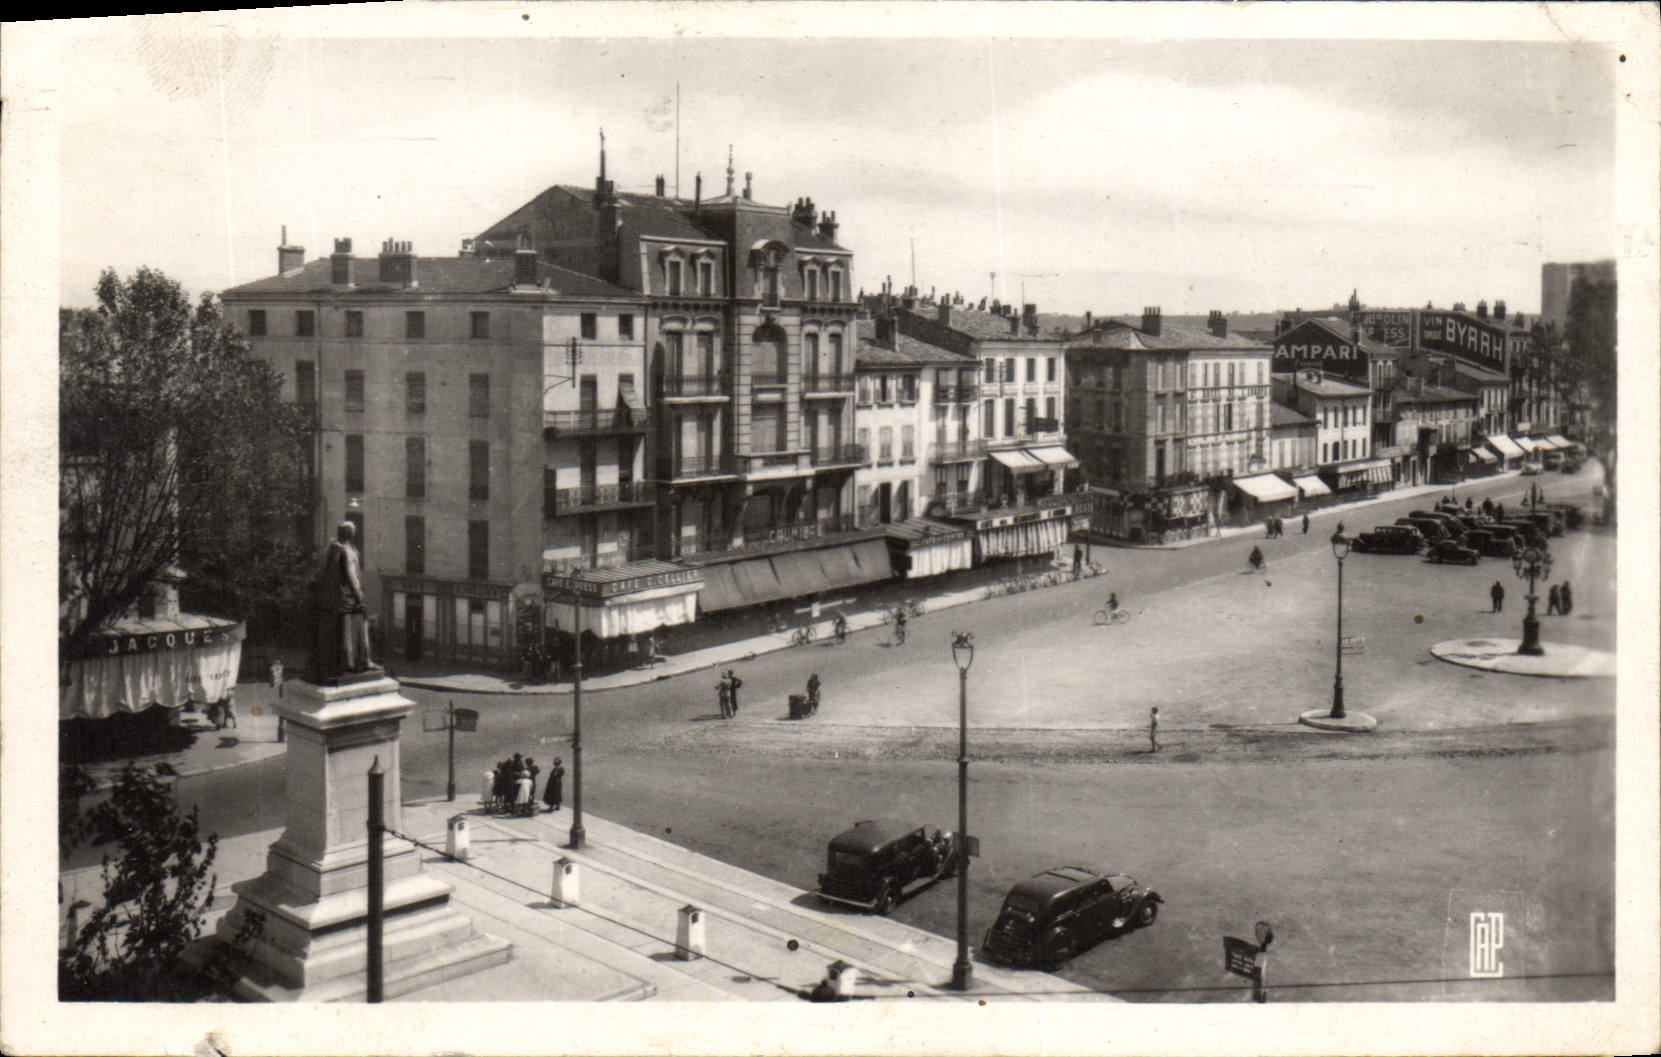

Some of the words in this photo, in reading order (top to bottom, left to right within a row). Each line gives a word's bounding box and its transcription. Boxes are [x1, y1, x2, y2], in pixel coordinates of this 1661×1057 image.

[1423, 316, 1442, 327] VIN
[1446, 317, 1503, 362] BYRRH
[1274, 344, 1358, 360] AMPARI
[108, 630, 229, 655] JACQUES
